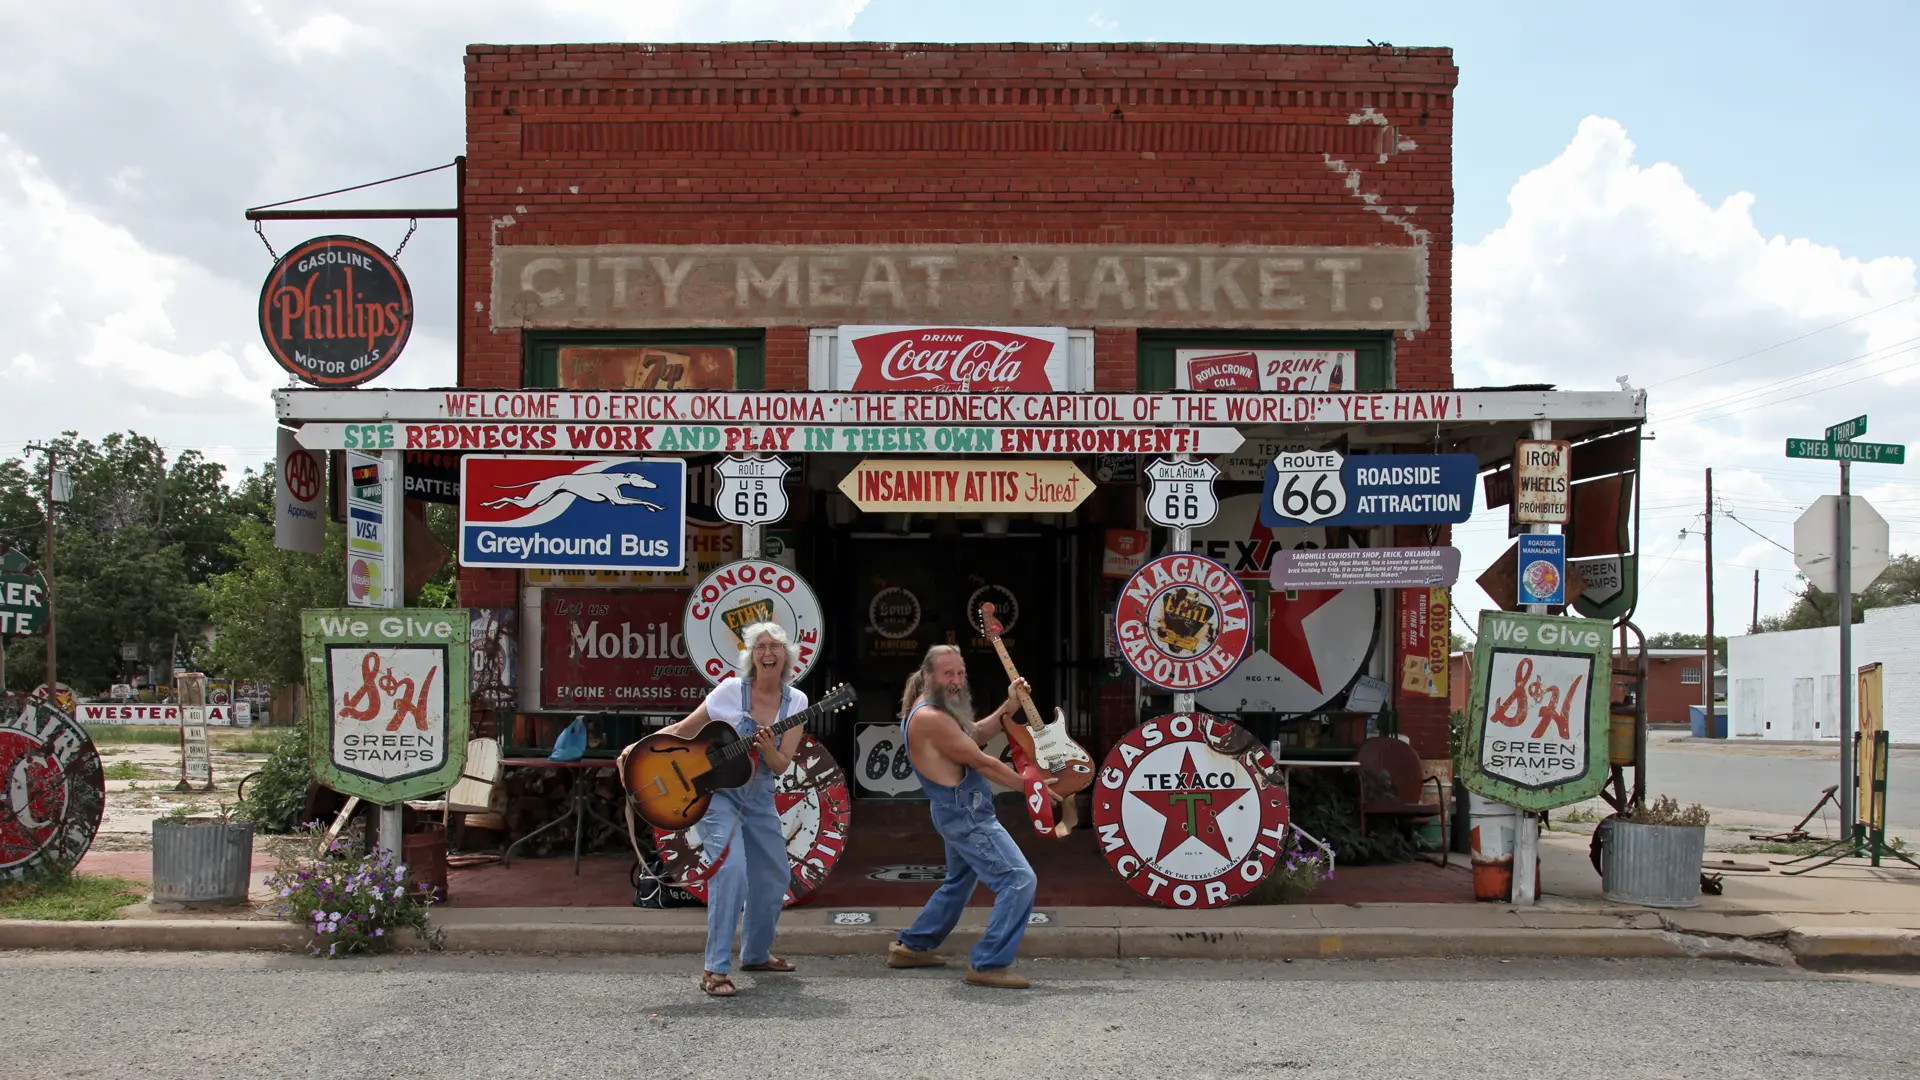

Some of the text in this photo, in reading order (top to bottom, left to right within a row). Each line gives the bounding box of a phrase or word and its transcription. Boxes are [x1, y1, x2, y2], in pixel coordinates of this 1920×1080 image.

[298, 252, 373, 272] GASOLINE
[519, 256, 700, 308] CITY
[733, 255, 956, 309] MEAT
[273, 267, 400, 351] Phillips
[921, 334, 964, 342] DRINK
[294, 349, 380, 373] MOTOR OILS
[881, 339, 1028, 382] Coca-Cola
[1267, 359, 1328, 377] DRINK
[1195, 362, 1253, 383] ROYAL CROWN
[1214, 377, 1236, 388] COLA
[446, 394, 559, 419] WELCOME
[571, 394, 600, 419] TO
[690, 396, 825, 421] OKLAHOMA
[904, 396, 1018, 421] REDNECK
[1024, 397, 1124, 421] CAPITOL
[1132, 397, 1161, 422] OF
[1172, 397, 1218, 422] THE
[1338, 396, 1385, 421] YEE
[1394, 395, 1463, 420] HAW!
[344, 425, 1200, 452] SEE REDNECKS WORK AND PLAY IN THEIR OWN ENVIRONMENT!
[1833, 422, 1856, 441] THIRD
[1526, 451, 1560, 467] IRON
[1799, 441, 1829, 457] SHEB
[1834, 443, 1882, 460] WOOLEY
[1886, 447, 1899, 455] AVE
[738, 464, 765, 475] ROUTE
[1283, 455, 1335, 469] ROUTE
[288, 457, 320, 495] AAA
[1159, 468, 1206, 479] OKLAHOMA
[1357, 467, 1441, 486] ROADSIDE
[362, 485, 382, 498] NOVUS
[857, 470, 1080, 502] INSANITY AT ITS Finest
[1283, 473, 1337, 516] 66
[1520, 477, 1565, 492] WHEELS
[287, 503, 317, 520] Approved
[735, 492, 767, 516] 66
[1166, 496, 1198, 518] 66
[1357, 494, 1461, 514] ATTRACTION
[1519, 502, 1566, 515] PROHIBITED
[356, 521, 378, 541] VISA
[477, 531, 669, 559] Greyhound Bus
[1292, 552, 1326, 560] SANDHILLS
[1327, 551, 1360, 559] CURIOSITY
[1362, 551, 1381, 559] SHOP,
[692, 565, 795, 620] CONOCO
[1127, 557, 1246, 633] MAGNOLIA
[555, 599, 609, 616] Let us
[726, 602, 773, 627] ETHYL
[1431, 603, 1446, 632] Old
[320, 616, 369, 638] We
[379, 617, 453, 638] Give
[1492, 620, 1600, 648] We Give
[1120, 619, 1235, 686] GASOLINE
[1431, 635, 1446, 674] Gold
[652, 664, 694, 680] your
[339, 652, 438, 731] S&H
[557, 687, 671, 698] ENGINE CHASSIS
[1490, 657, 1583, 739] S&H
[343, 734, 434, 747] GREEN
[1491, 741, 1576, 756] GREEN
[343, 749, 434, 762] STAMPS
[1491, 755, 1576, 770] STAMPS
[1144, 773, 1235, 790] TEXACO
[1098, 823, 1285, 907] MOTOR OIL
[1213, 855, 1242, 876] COMPANY
